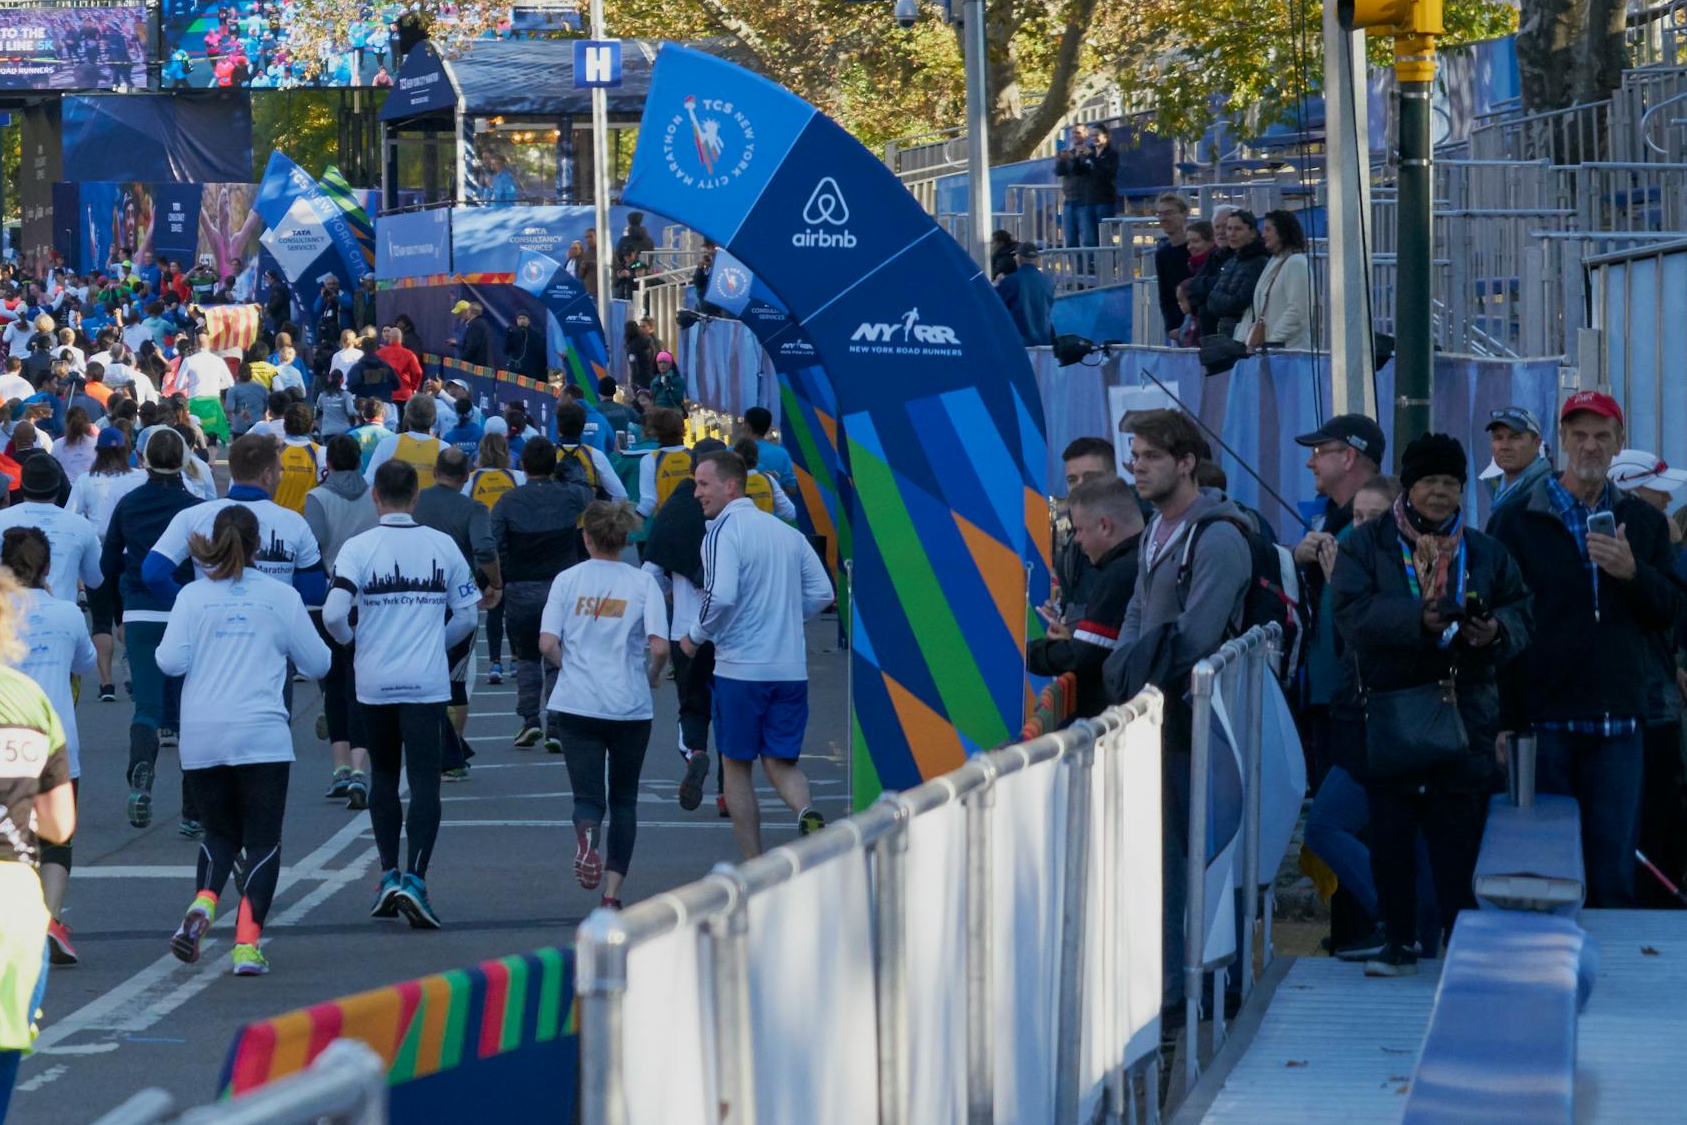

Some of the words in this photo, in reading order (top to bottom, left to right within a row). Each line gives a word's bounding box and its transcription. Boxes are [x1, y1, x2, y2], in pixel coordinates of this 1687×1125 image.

[0, 27, 20, 39] TO
[22, 27, 46, 39] THE
[6, 39, 34, 51] LINE
[36, 39, 55, 51] 5K
[586, 46, 611, 82] H
[18, 66, 55, 75] RUNNERS
[702, 99, 734, 114] TCS
[733, 111, 755, 140] NEW
[663, 114, 694, 187] MARATHON
[731, 143, 755, 178] YORK
[697, 175, 730, 189] CITY
[521, 227, 547, 235] TATA
[278, 236, 325, 244] CONSULTANCY
[509, 235, 563, 244] CONSULTANCY
[792, 228, 858, 249] airbnb
[849, 345, 870, 354] NEW
[871, 346, 894, 355] YORK
[896, 347, 920, 356] ROAD
[922, 348, 963, 357] RUNNERS
[363, 596, 381, 606] New
[382, 596, 399, 606] York
